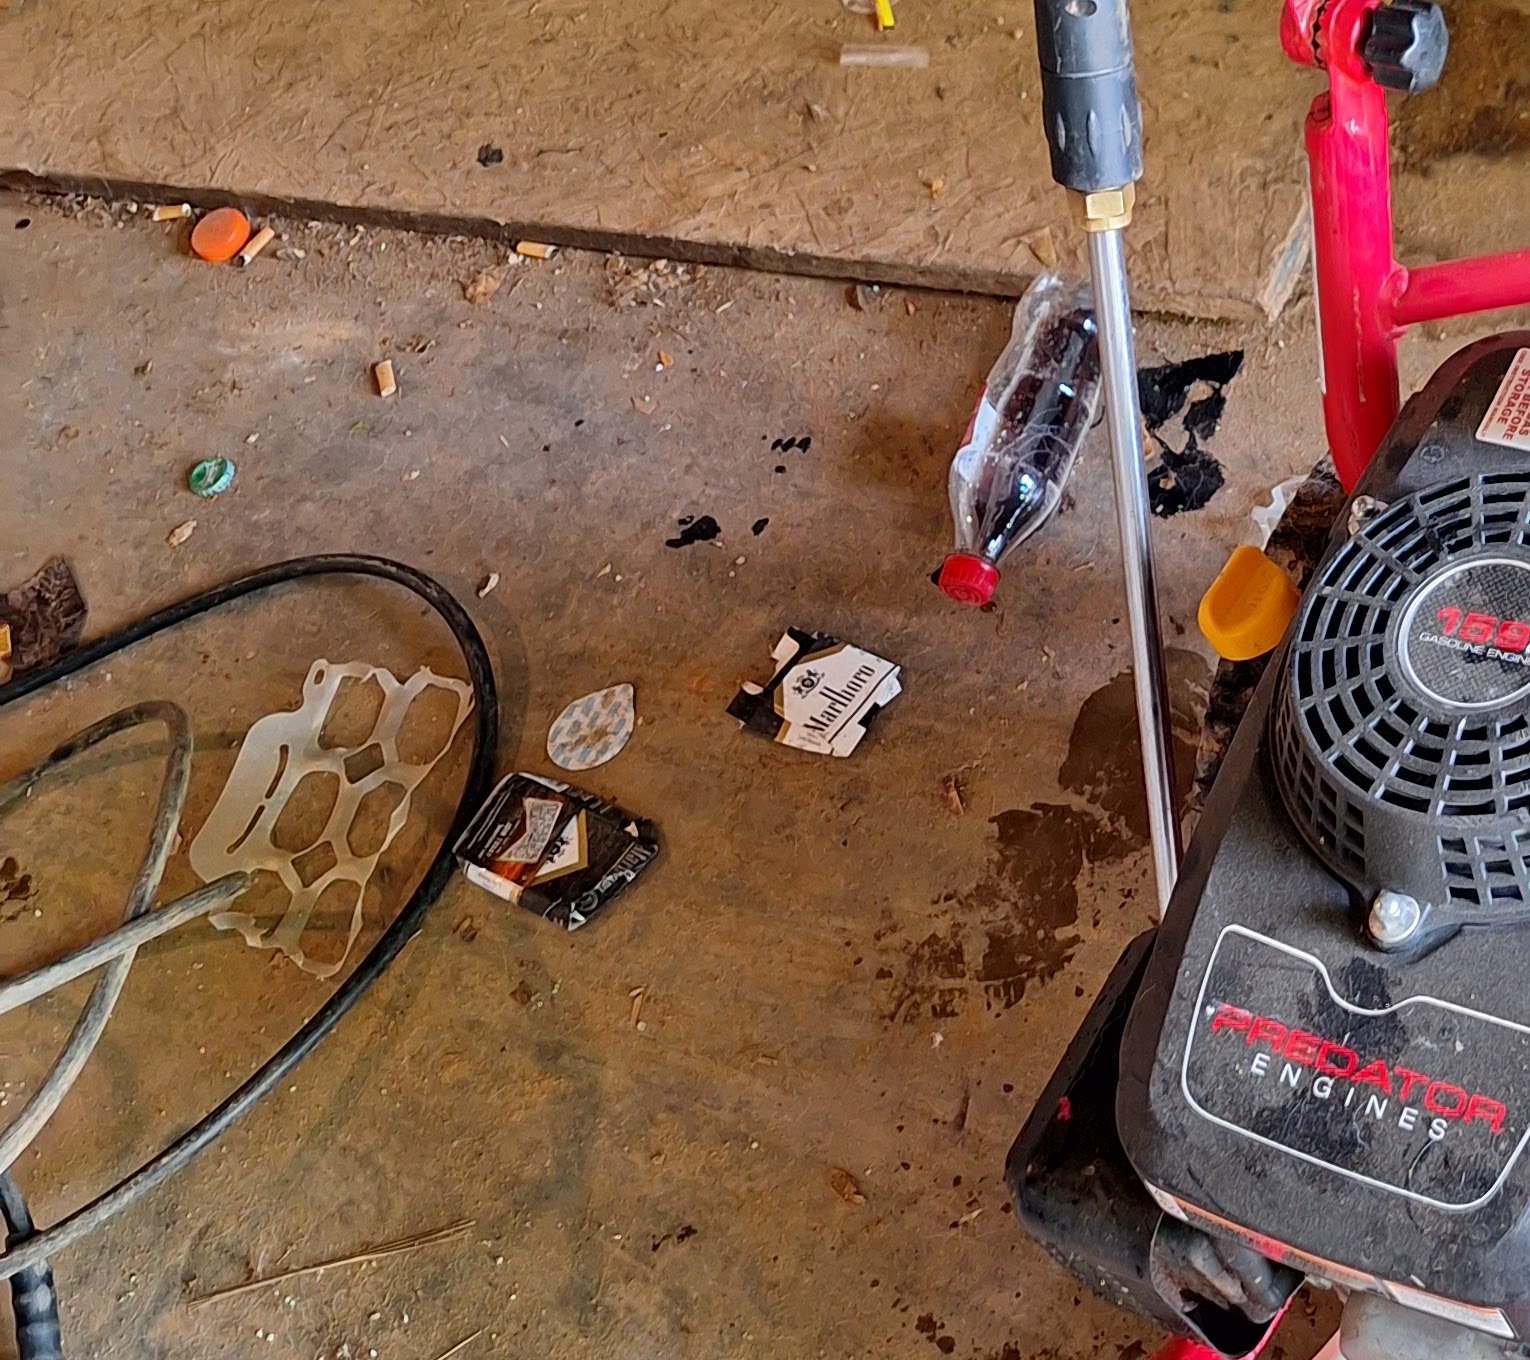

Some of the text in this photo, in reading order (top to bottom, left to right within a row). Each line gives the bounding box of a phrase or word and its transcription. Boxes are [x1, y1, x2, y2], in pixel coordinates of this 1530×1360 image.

[1499, 366, 1529, 427] STORAGE
[1503, 391, 1530, 443] BEFORE
[1419, 631, 1486, 655] GASOLINE
[795, 651, 876, 740] Marlboro
[1210, 1002, 1507, 1135] PREDATOR
[1250, 1051, 1449, 1142] ENGINES
